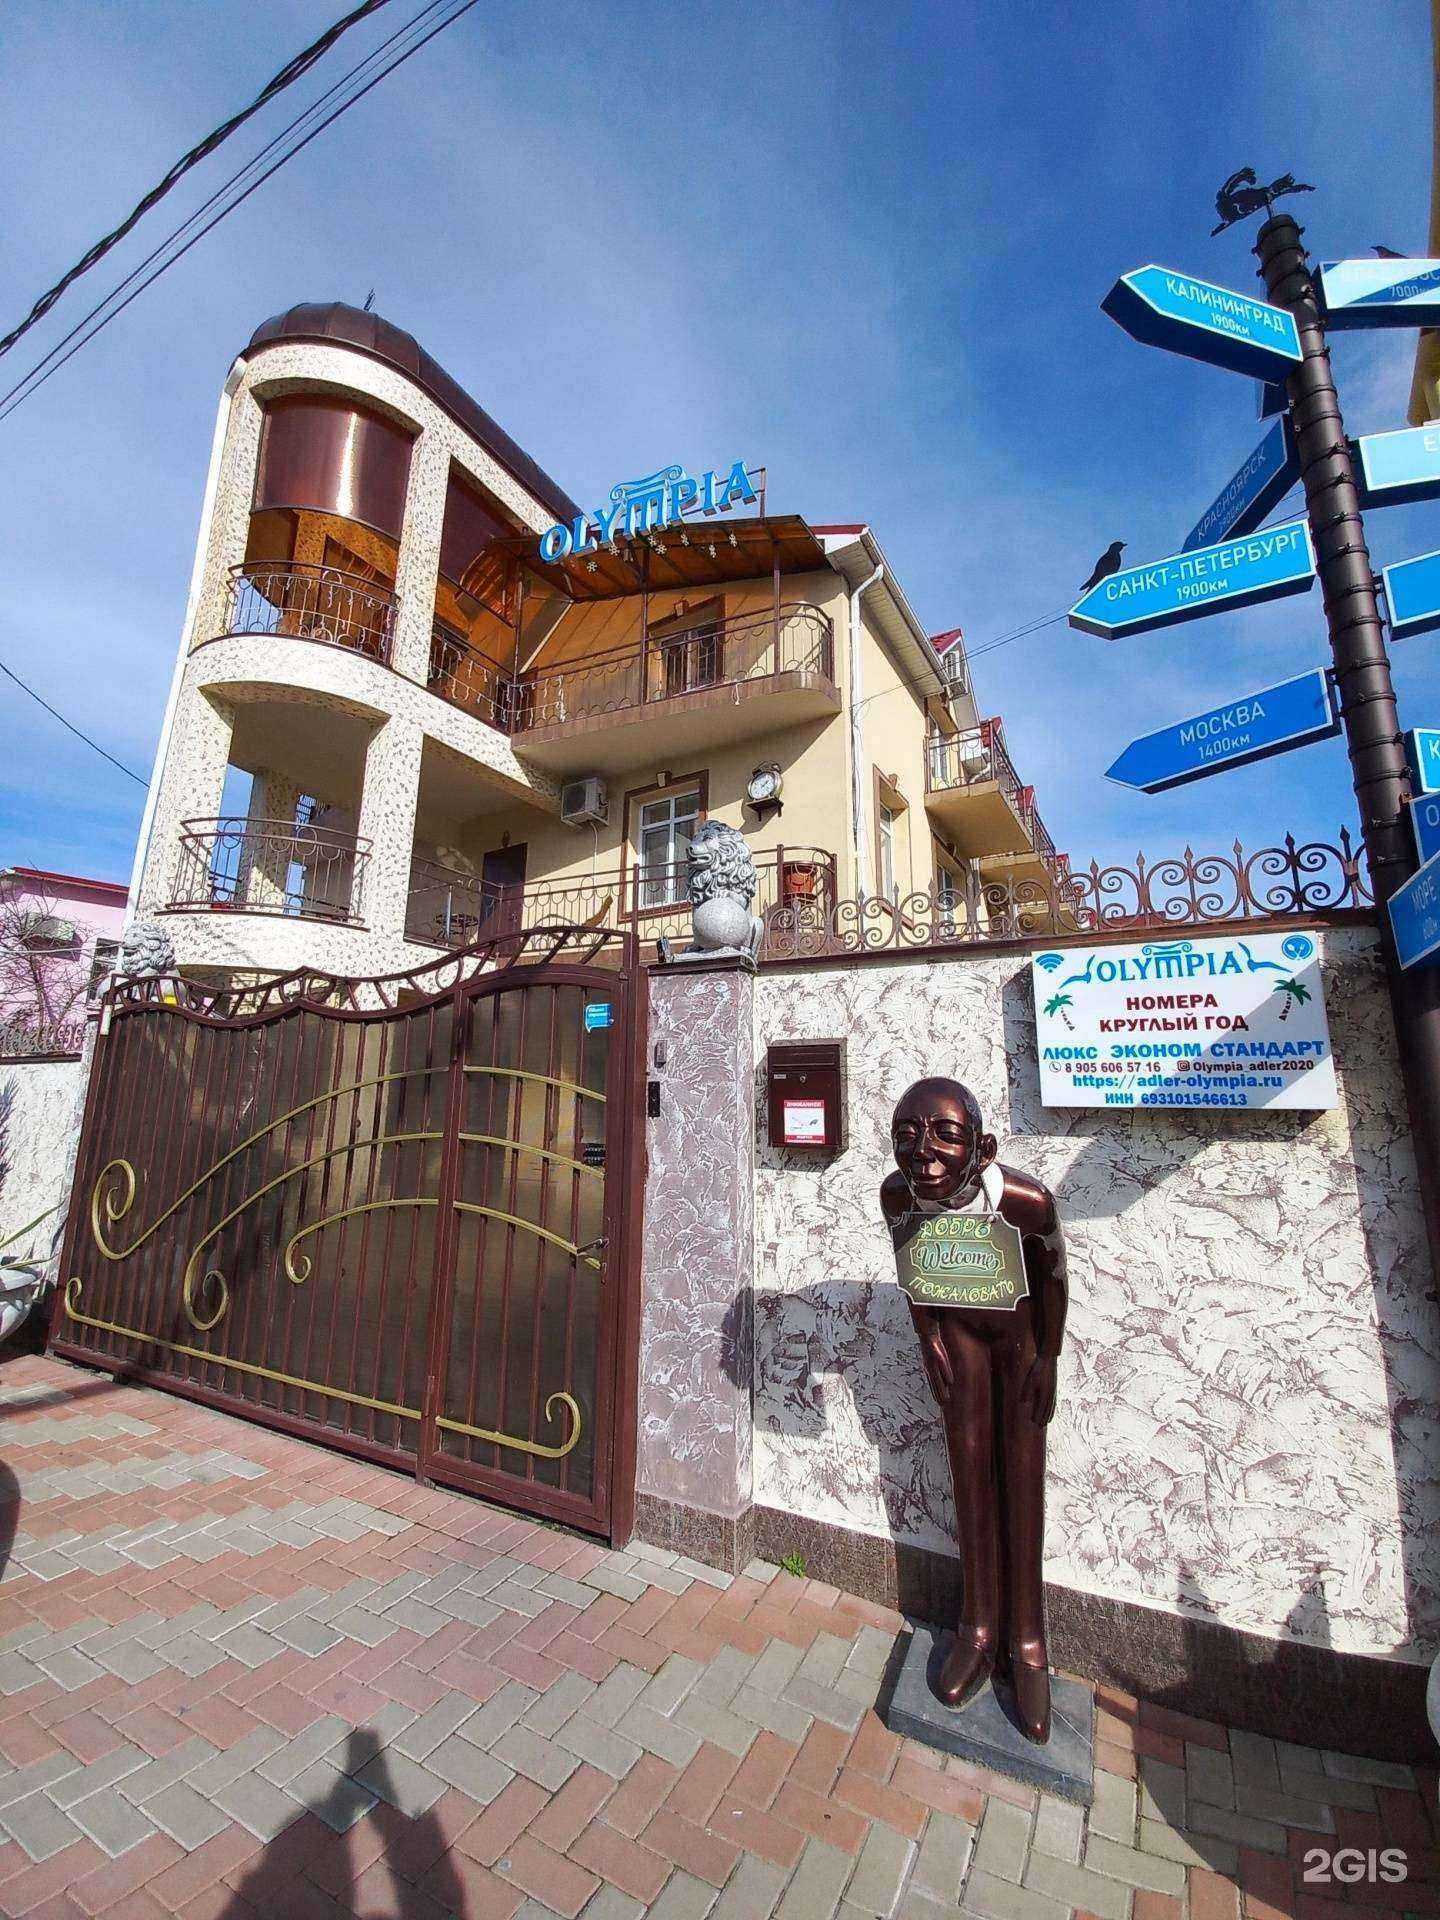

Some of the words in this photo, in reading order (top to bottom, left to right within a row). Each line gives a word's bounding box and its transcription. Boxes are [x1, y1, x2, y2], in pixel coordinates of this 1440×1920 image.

[1166, 277, 1286, 335] КАЛИНИНГРАД
[1210, 312, 1251, 337] 1900км
[1198, 447, 1266, 538] КРАСНОЯРСК
[540, 461, 757, 563] OLYMPIA
[1106, 529, 1302, 602] САНКТ-ПЕТЕРБУРГ
[1176, 578, 1228, 602] 1900км
[1179, 702, 1266, 747] МОСКВА
[1198, 734, 1251, 761] 1400км
[1097, 944, 1243, 983] OLYMPIA
[1126, 993, 1218, 1011] НОМЕРА
[1100, 1013, 1198, 1032] КРУГЛЫЙ
[1205, 1015, 1249, 1031] ГОД
[1043, 1045, 1098, 1060] ЛЮКС
[1110, 1043, 1202, 1059] ЭКОНОМ
[1210, 1040, 1324, 1059] СТАНДАРТ
[1065, 1062, 1073, 1073] 8
[1075, 1062, 1098, 1073] 905
[1127, 1061, 1142, 1072] 57
[1147, 1061, 1161, 1072] 16
[1105, 1093, 1134, 1104] ИНН
[919, 1217, 992, 1240] ДОБРО
[916, 1241, 999, 1271] Welcome
[908, 1276, 1015, 1303] ПОЖАЛОВАТЬ
